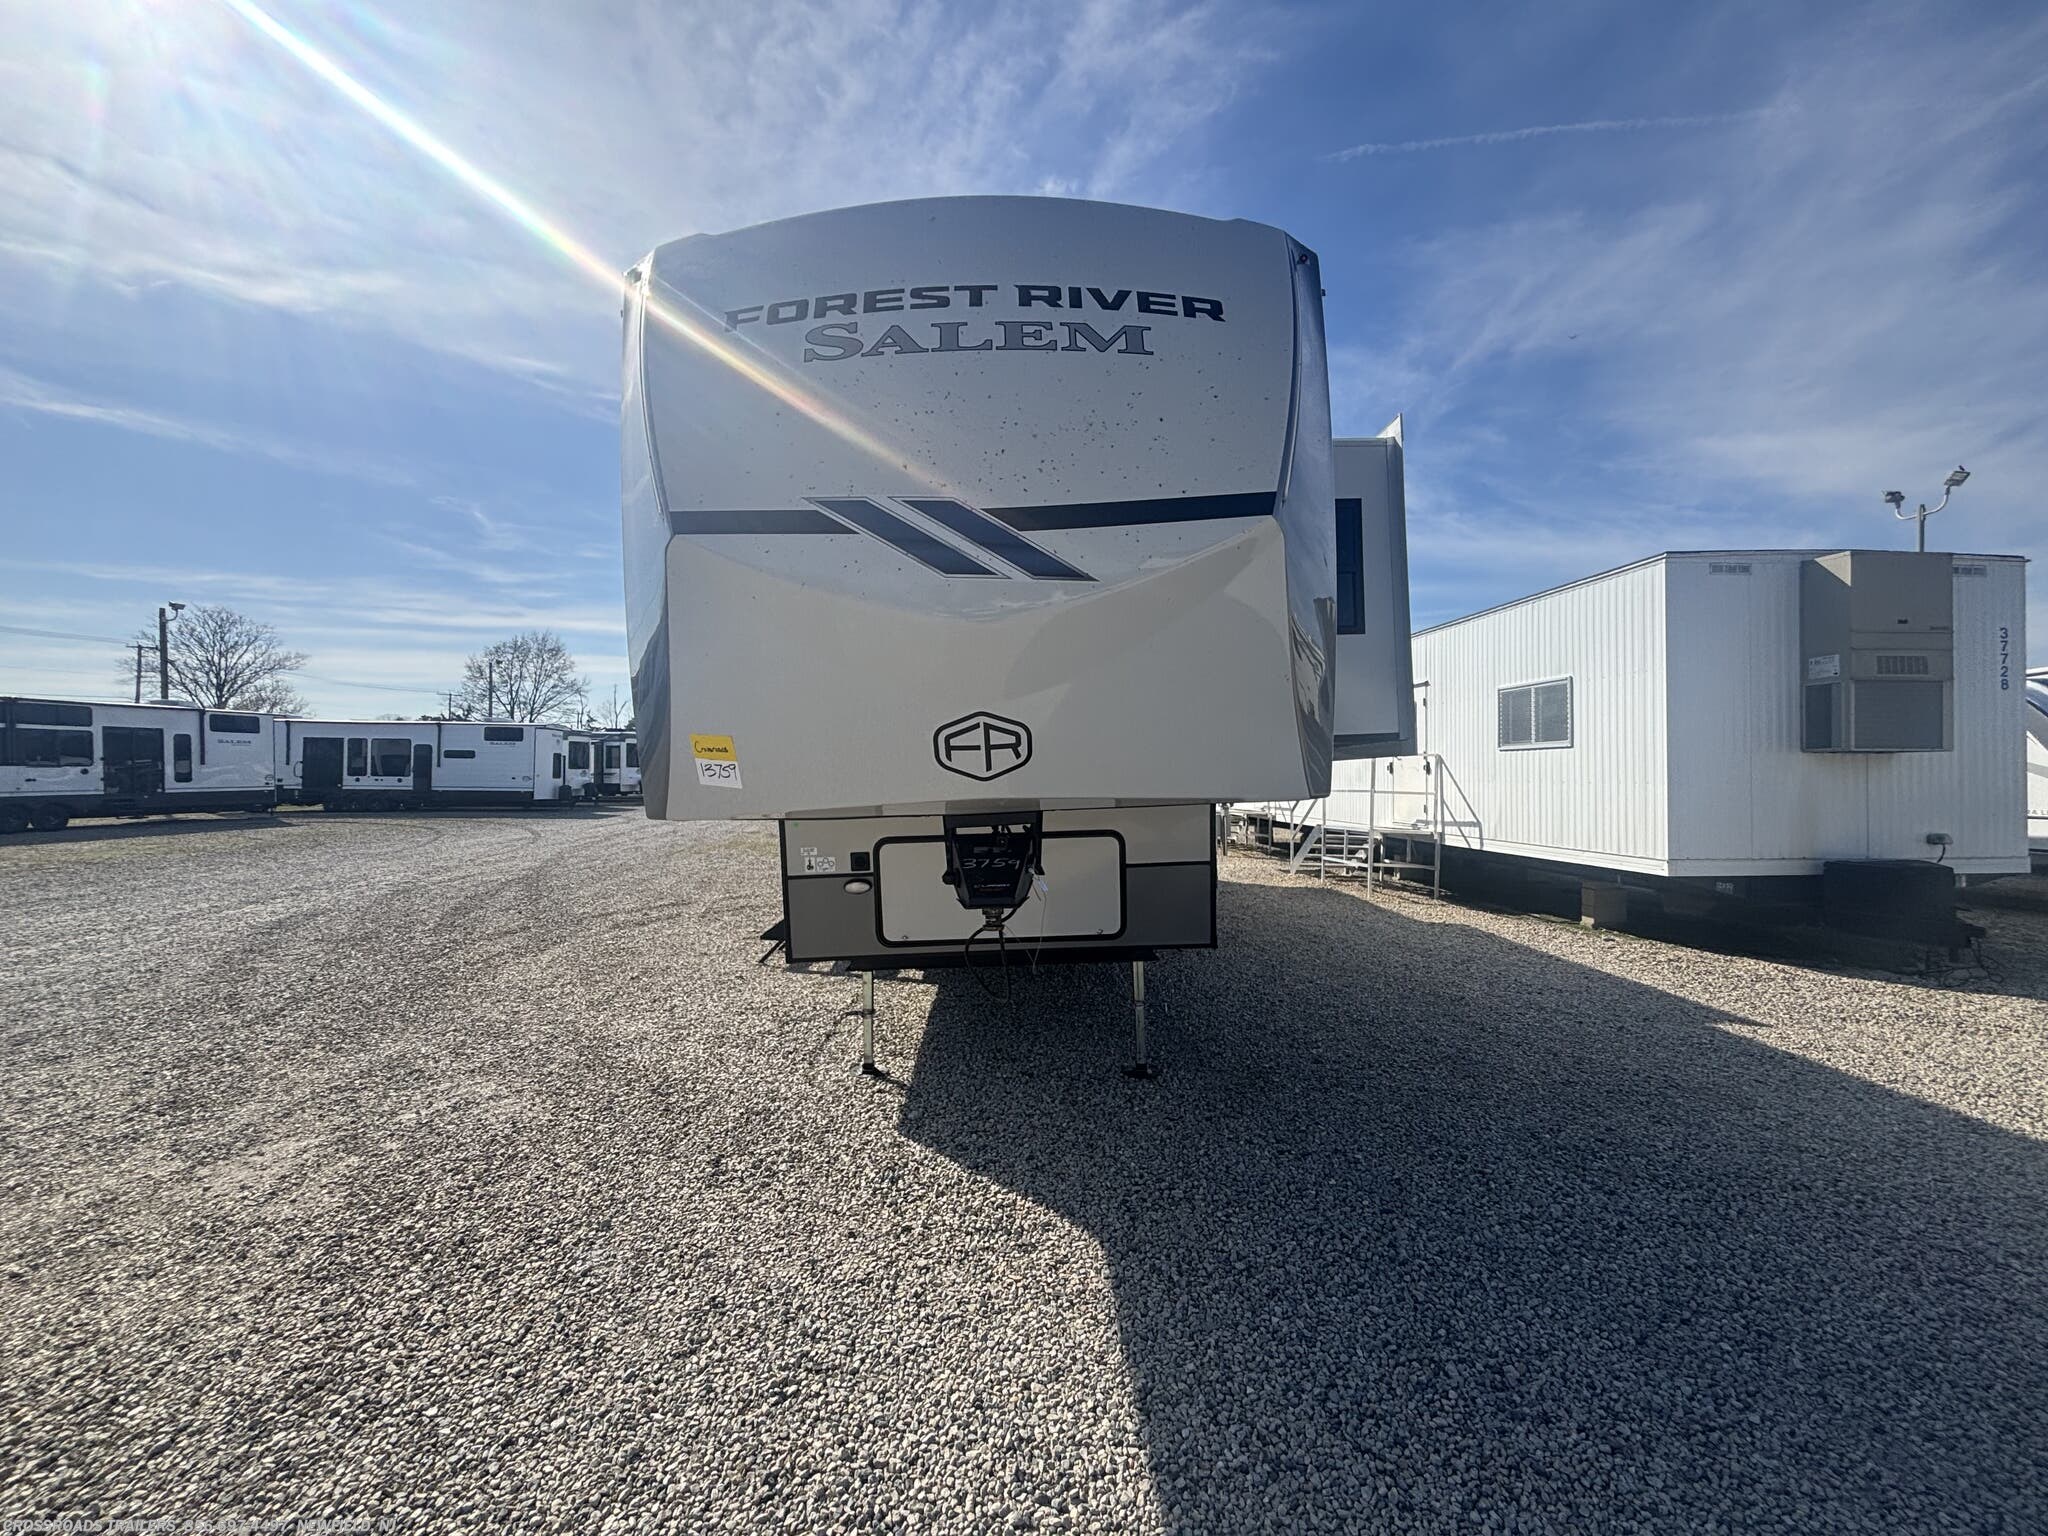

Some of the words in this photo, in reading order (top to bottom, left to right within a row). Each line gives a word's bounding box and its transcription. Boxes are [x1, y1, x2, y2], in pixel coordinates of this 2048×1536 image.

[725, 284, 998, 331] FOREST
[1013, 284, 1227, 322] RIVER
[804, 319, 1154, 363] SALEM
[1999, 627, 2010, 690] 37728
[700, 763, 738, 781] 13759
[962, 857, 1021, 870] 3759
